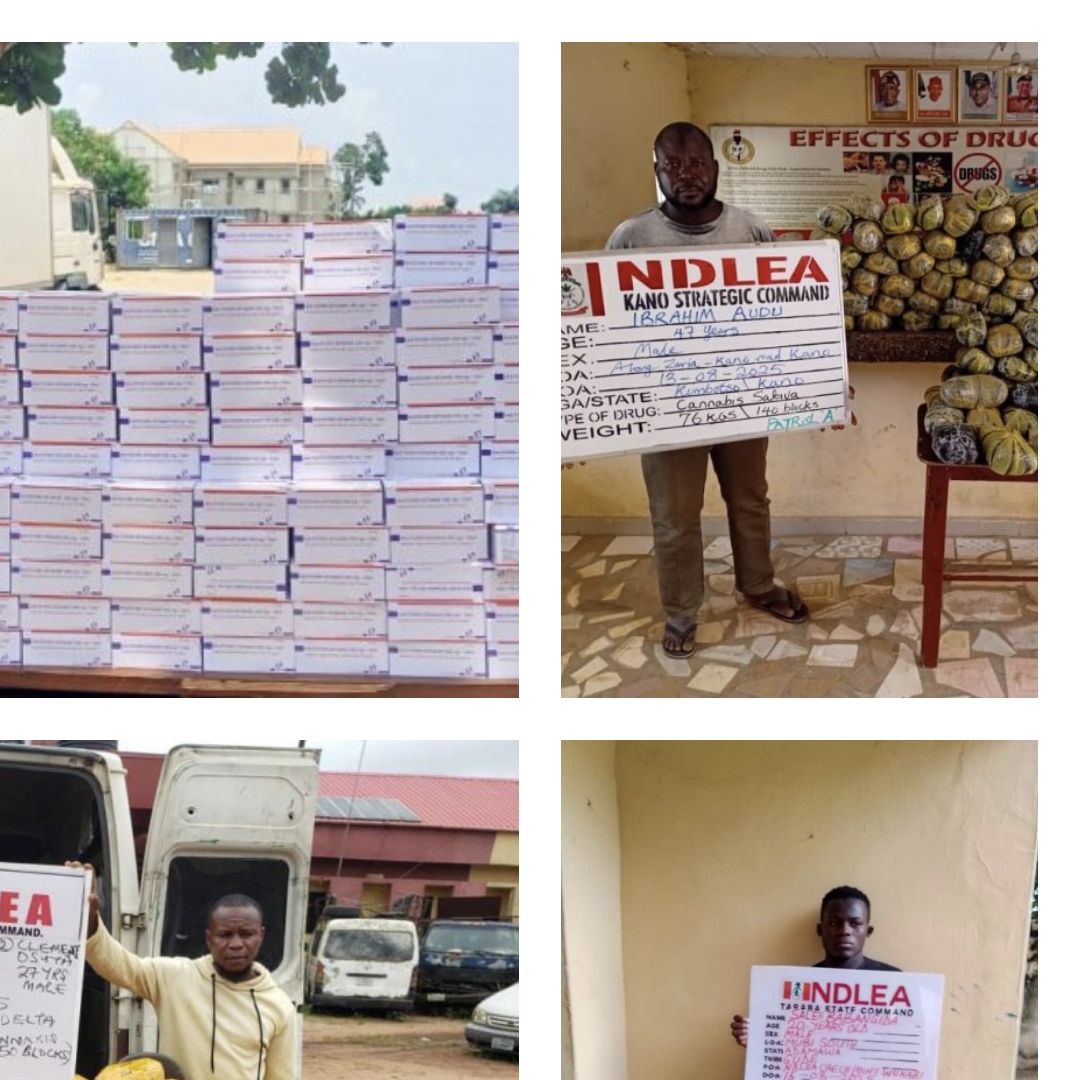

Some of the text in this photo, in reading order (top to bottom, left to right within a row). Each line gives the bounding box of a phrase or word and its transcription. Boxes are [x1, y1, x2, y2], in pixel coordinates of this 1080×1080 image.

[789, 130, 911, 148] EFFECTS
[917, 130, 959, 148] OF
[958, 167, 998, 181] DRUGS
[616, 255, 830, 292] NDLEA
[623, 285, 830, 312] KANO STRATEGIC COMMAND
[632, 306, 783, 326] IBRAHIM AUDU
[589, 407, 661, 423] OF DRUG:
[810, 981, 912, 1007] NDLEA
[860, 1007, 914, 1017] COMMAND
[783, 1030, 814, 1039] MALE
